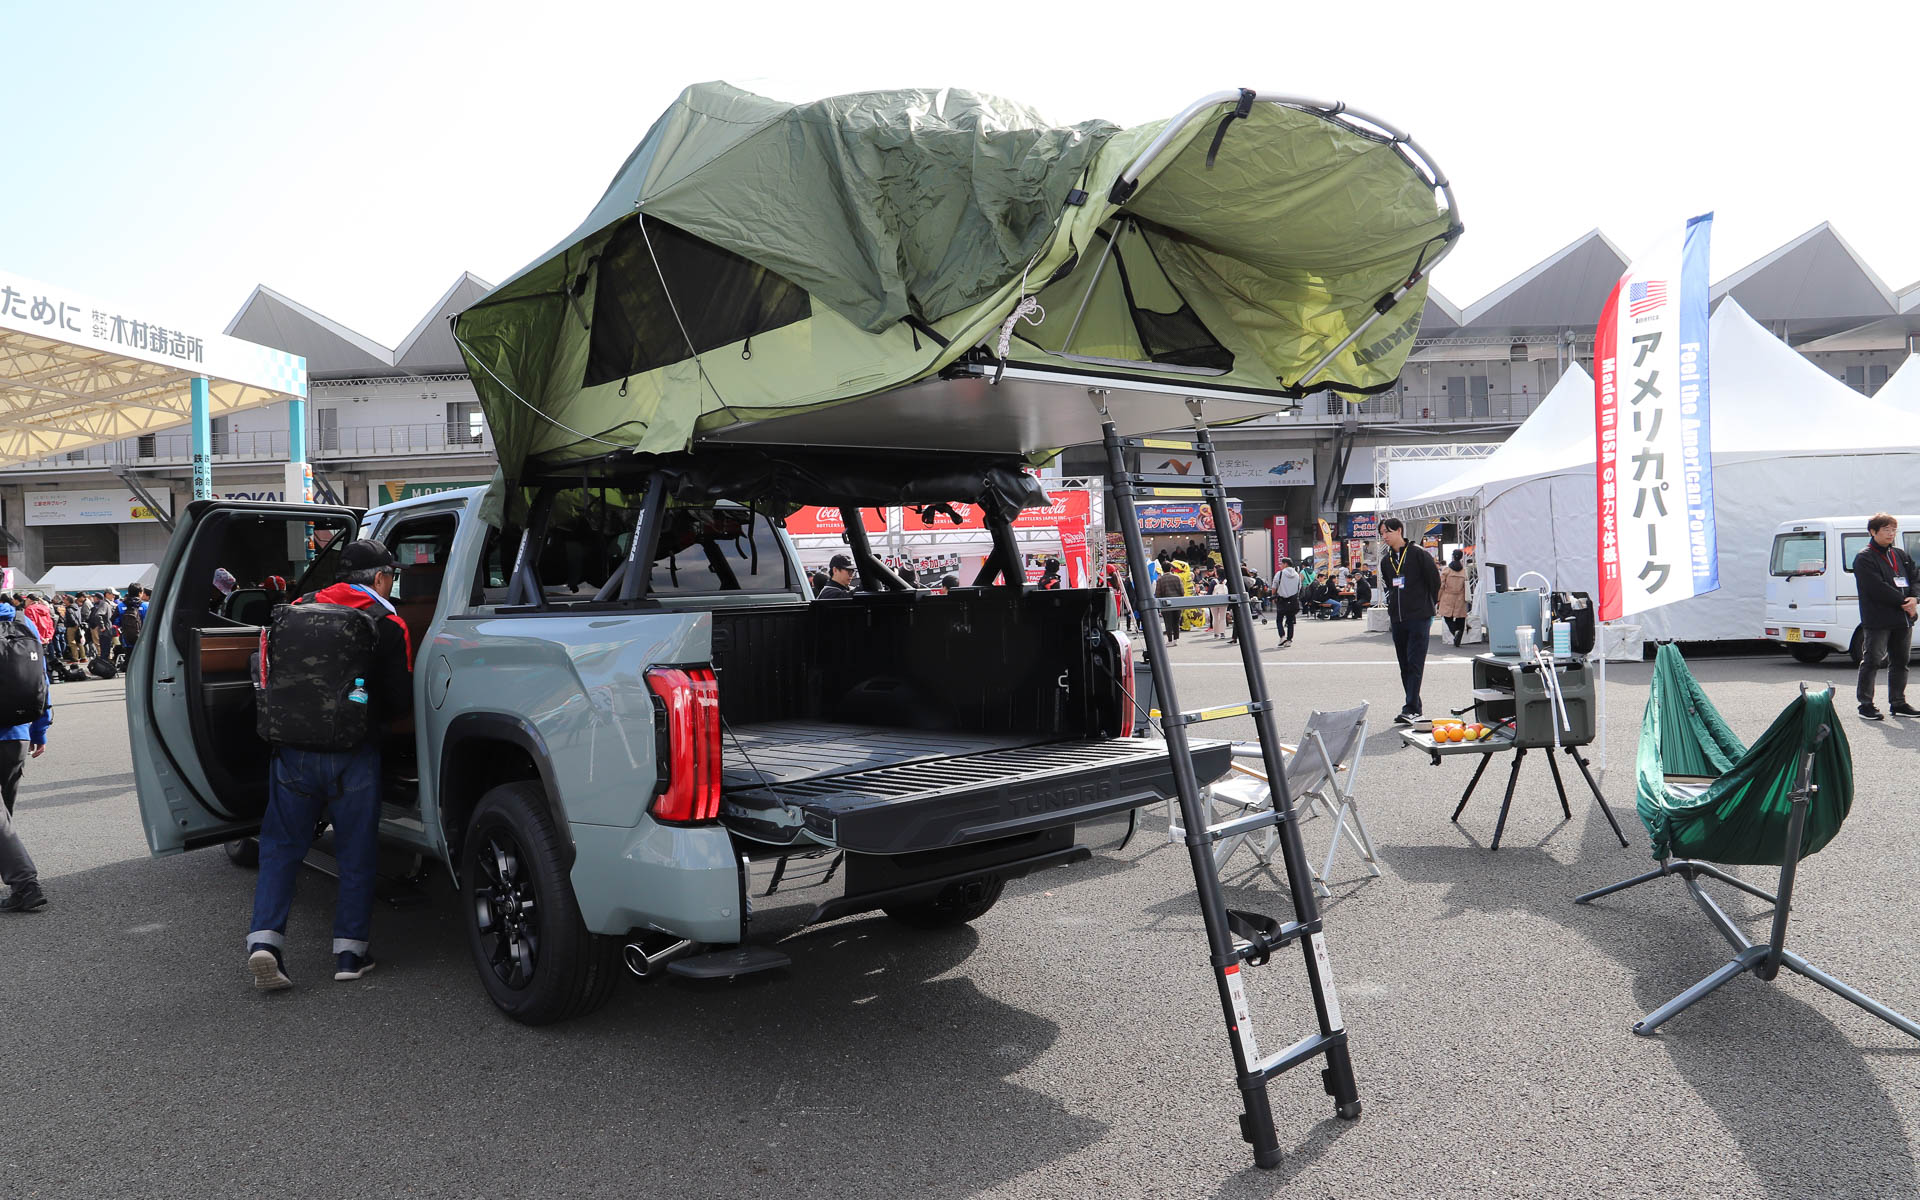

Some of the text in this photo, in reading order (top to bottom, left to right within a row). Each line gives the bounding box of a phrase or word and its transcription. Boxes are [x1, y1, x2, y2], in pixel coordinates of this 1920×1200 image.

[1, 285, 82, 333] ために
[109, 314, 204, 363] 木村鋳造所
[1602, 357, 1616, 405] Made
[1681, 384, 1701, 415] the
[1602, 429, 1616, 463] USA
[1631, 331, 1671, 594] アメリカパーク
[1008, 781, 1114, 817] TUNDRA
